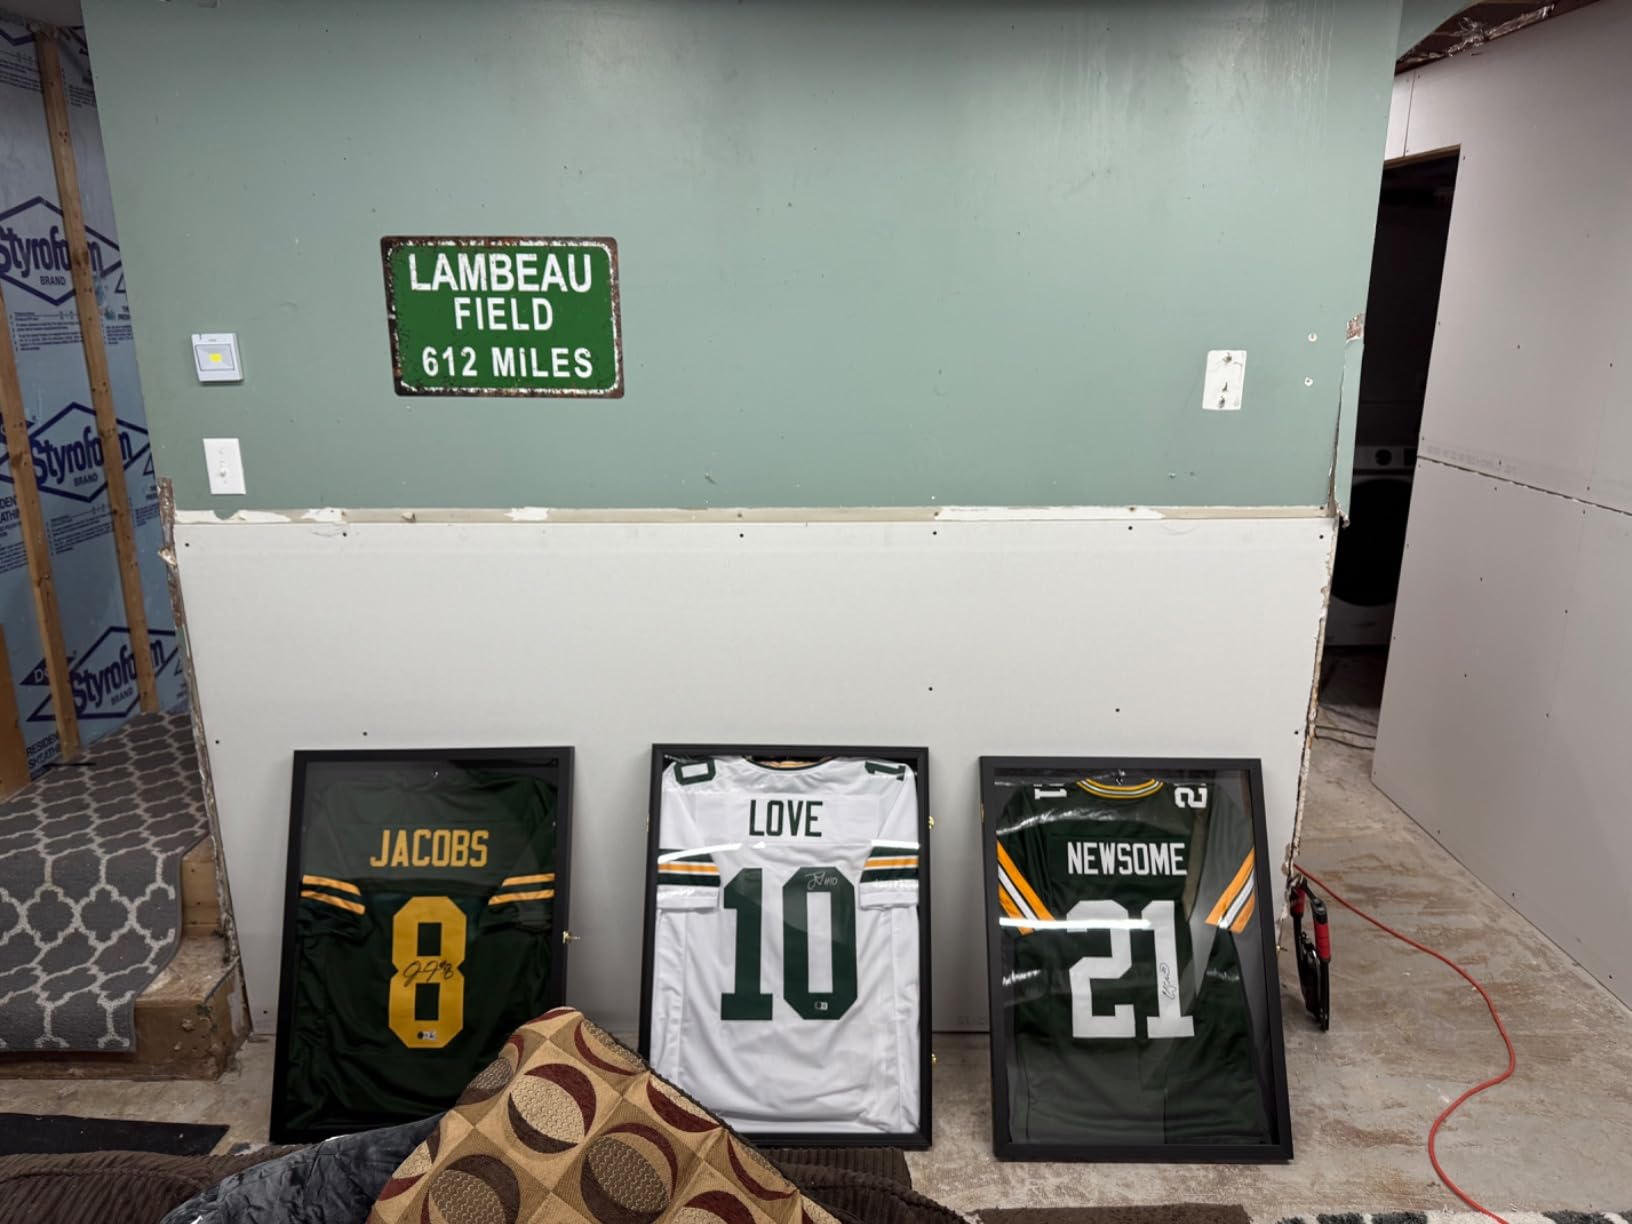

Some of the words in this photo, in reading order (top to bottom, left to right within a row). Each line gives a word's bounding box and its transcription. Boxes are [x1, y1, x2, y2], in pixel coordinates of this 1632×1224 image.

[0, 225, 104, 278] Styrofom
[40, 275, 66, 286] BRAND
[408, 253, 593, 293] LAMBEAU
[454, 297, 553, 331] FIELD
[422, 346, 478, 377] 612
[491, 347, 593, 378] MILES
[31, 426, 133, 485] Styrofom
[73, 473, 98, 487] BRAND
[69, 639, 165, 714] Styrofom
[749, 799, 823, 837] LOVE
[369, 829, 489, 867] JACOBS
[1067, 842, 1187, 875] NEWSOME
[721, 867, 858, 1020] 10
[388, 896, 467, 1048] 8
[1066, 900, 1195, 1039] 21
